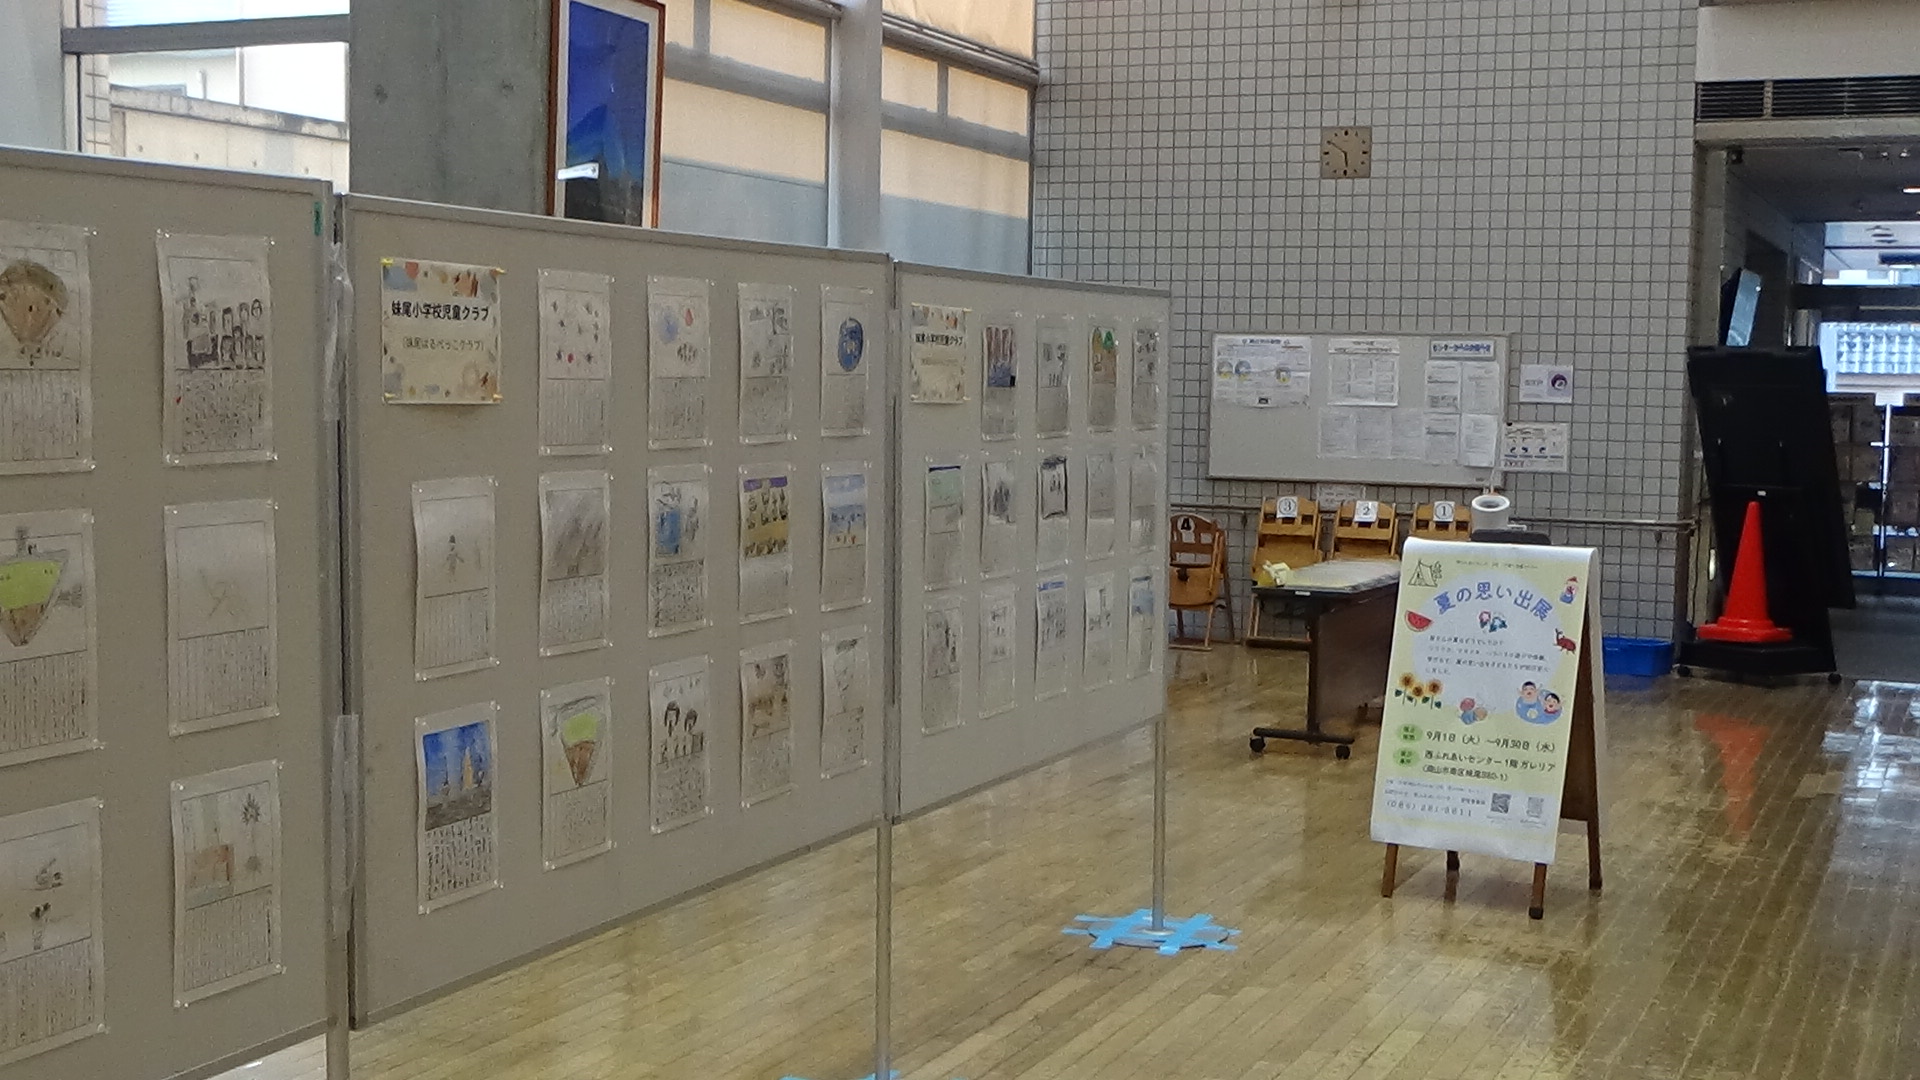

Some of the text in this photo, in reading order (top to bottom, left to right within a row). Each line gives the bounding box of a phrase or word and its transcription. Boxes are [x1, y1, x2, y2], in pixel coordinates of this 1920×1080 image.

[1433, 581, 1553, 621] 夏の思い出展
